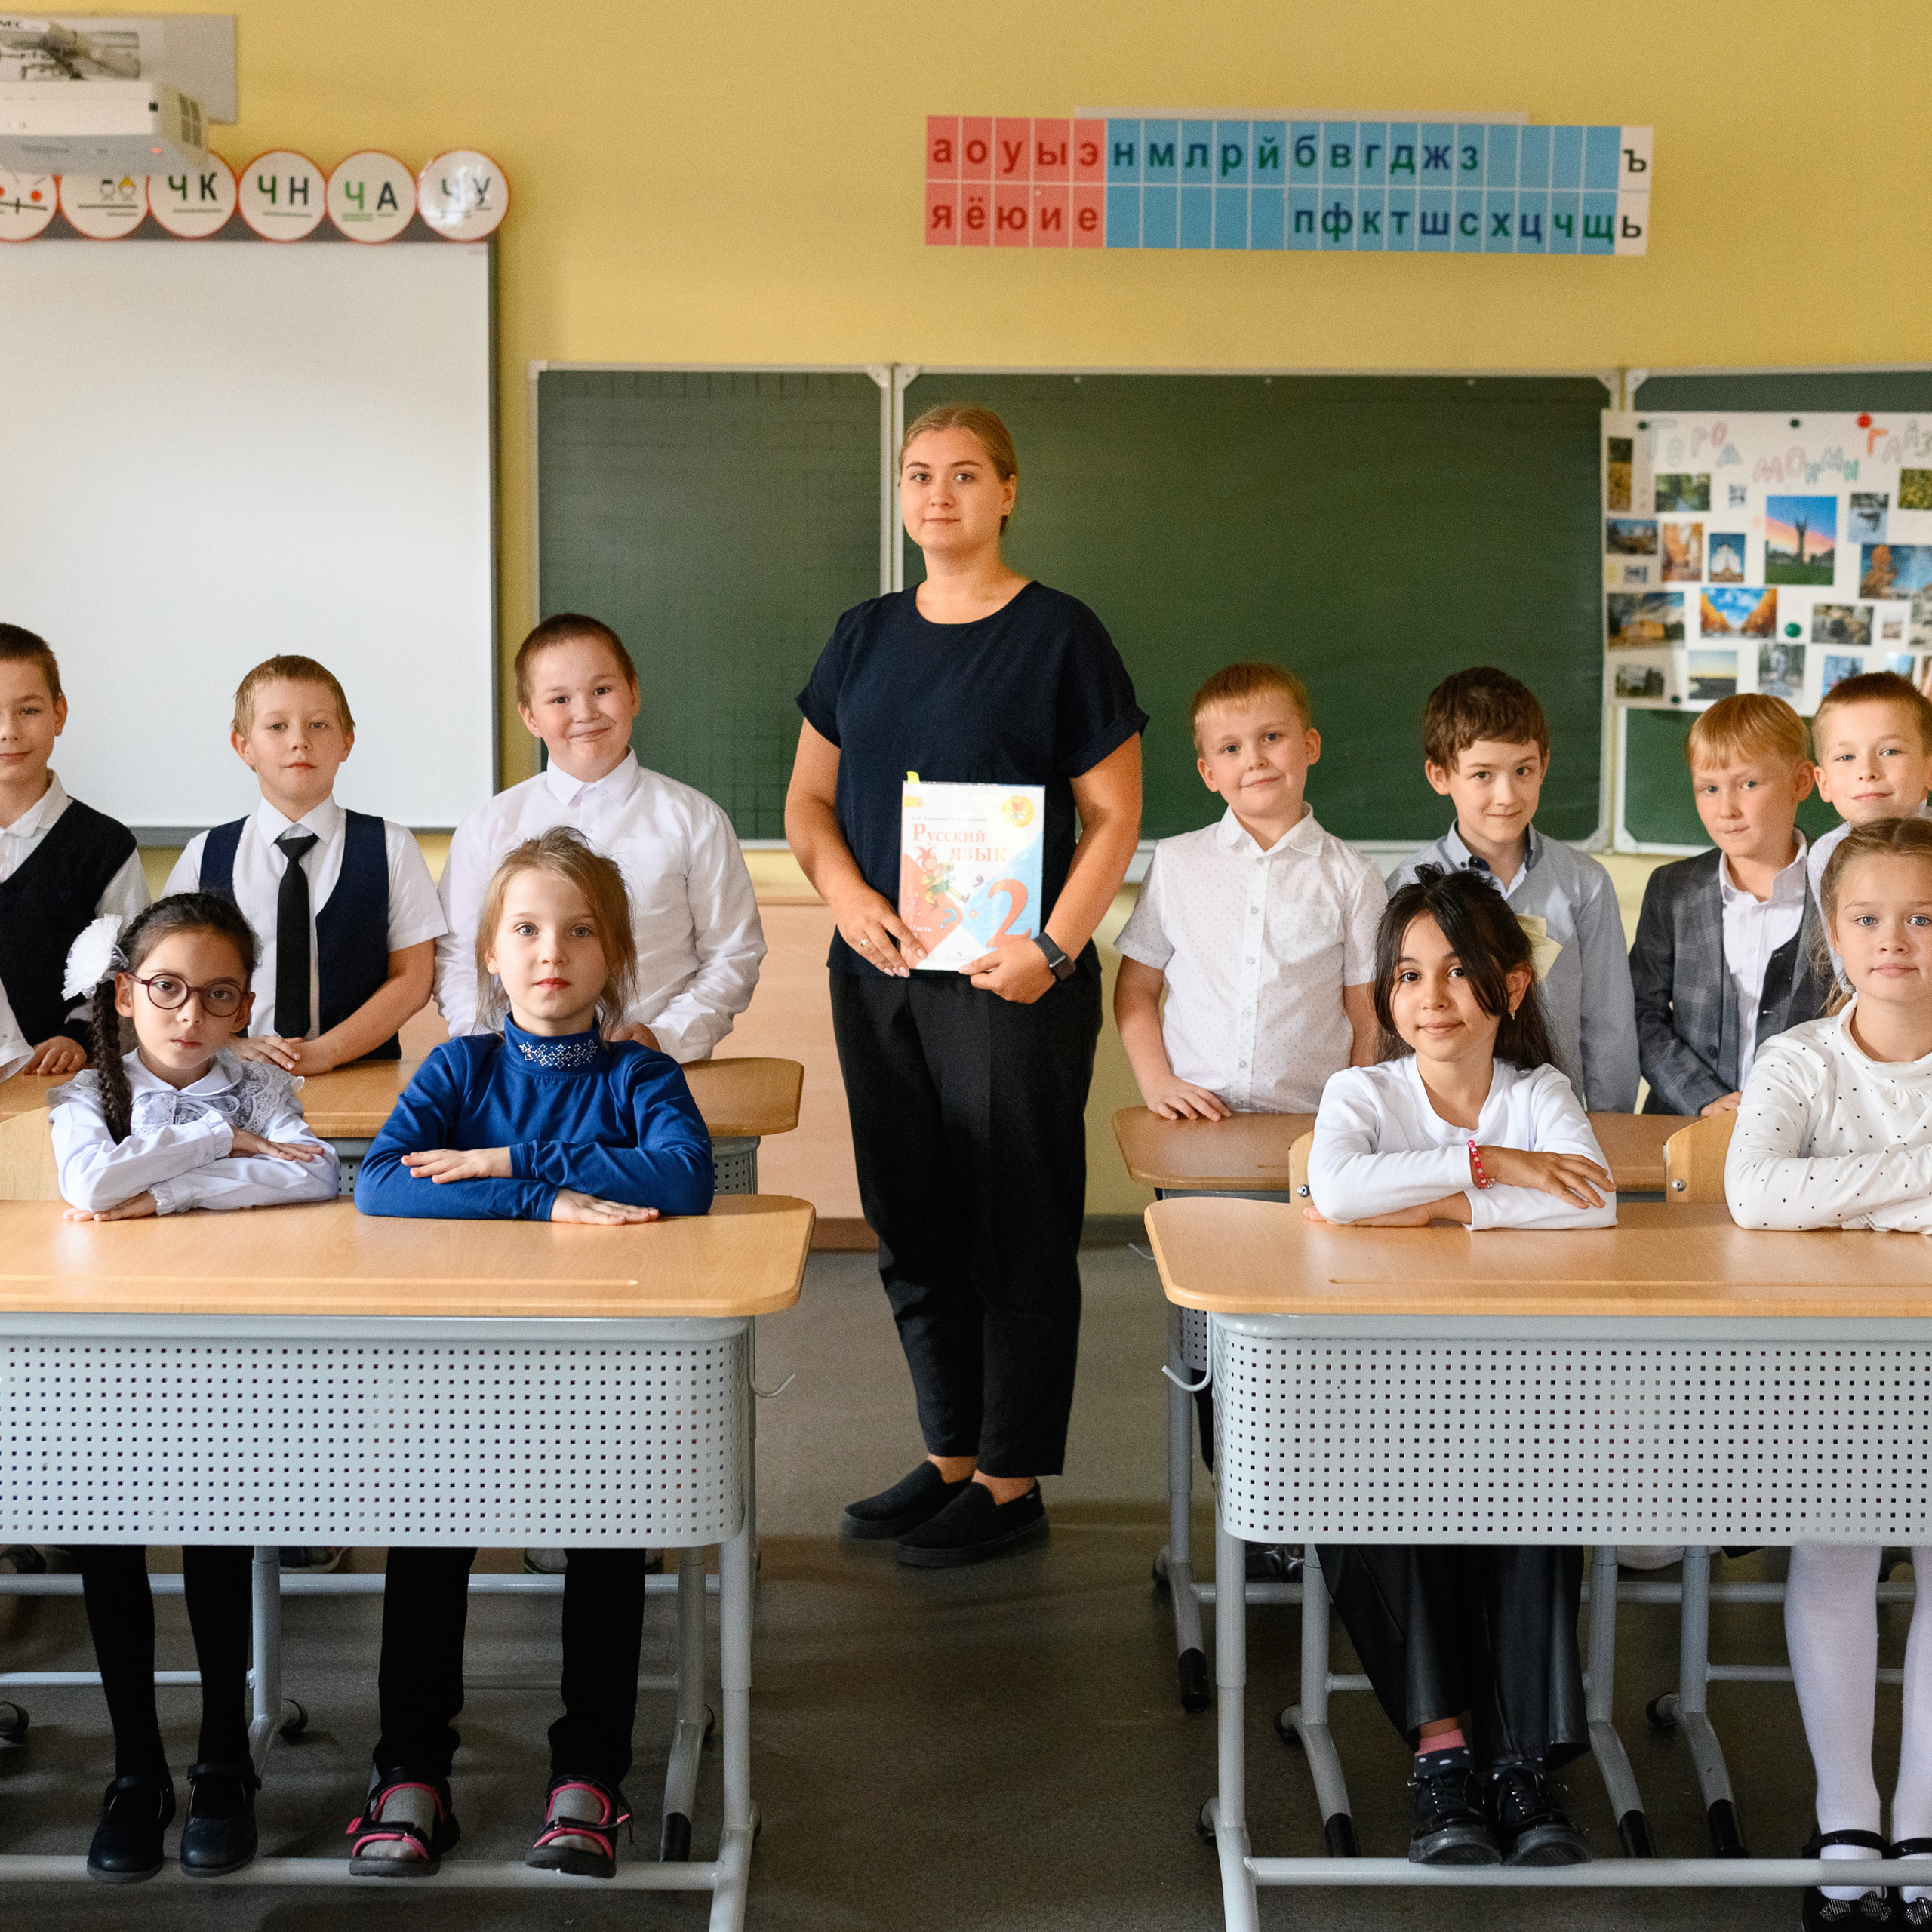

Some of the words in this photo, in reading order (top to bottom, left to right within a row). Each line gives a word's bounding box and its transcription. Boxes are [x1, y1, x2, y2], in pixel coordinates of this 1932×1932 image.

[168, 171, 217, 201] ЧК
[257, 174, 309, 205] ЧН
[345, 181, 398, 211] ЧА
[912, 823, 986, 845] Русский
[986, 878, 1031, 948] 2
